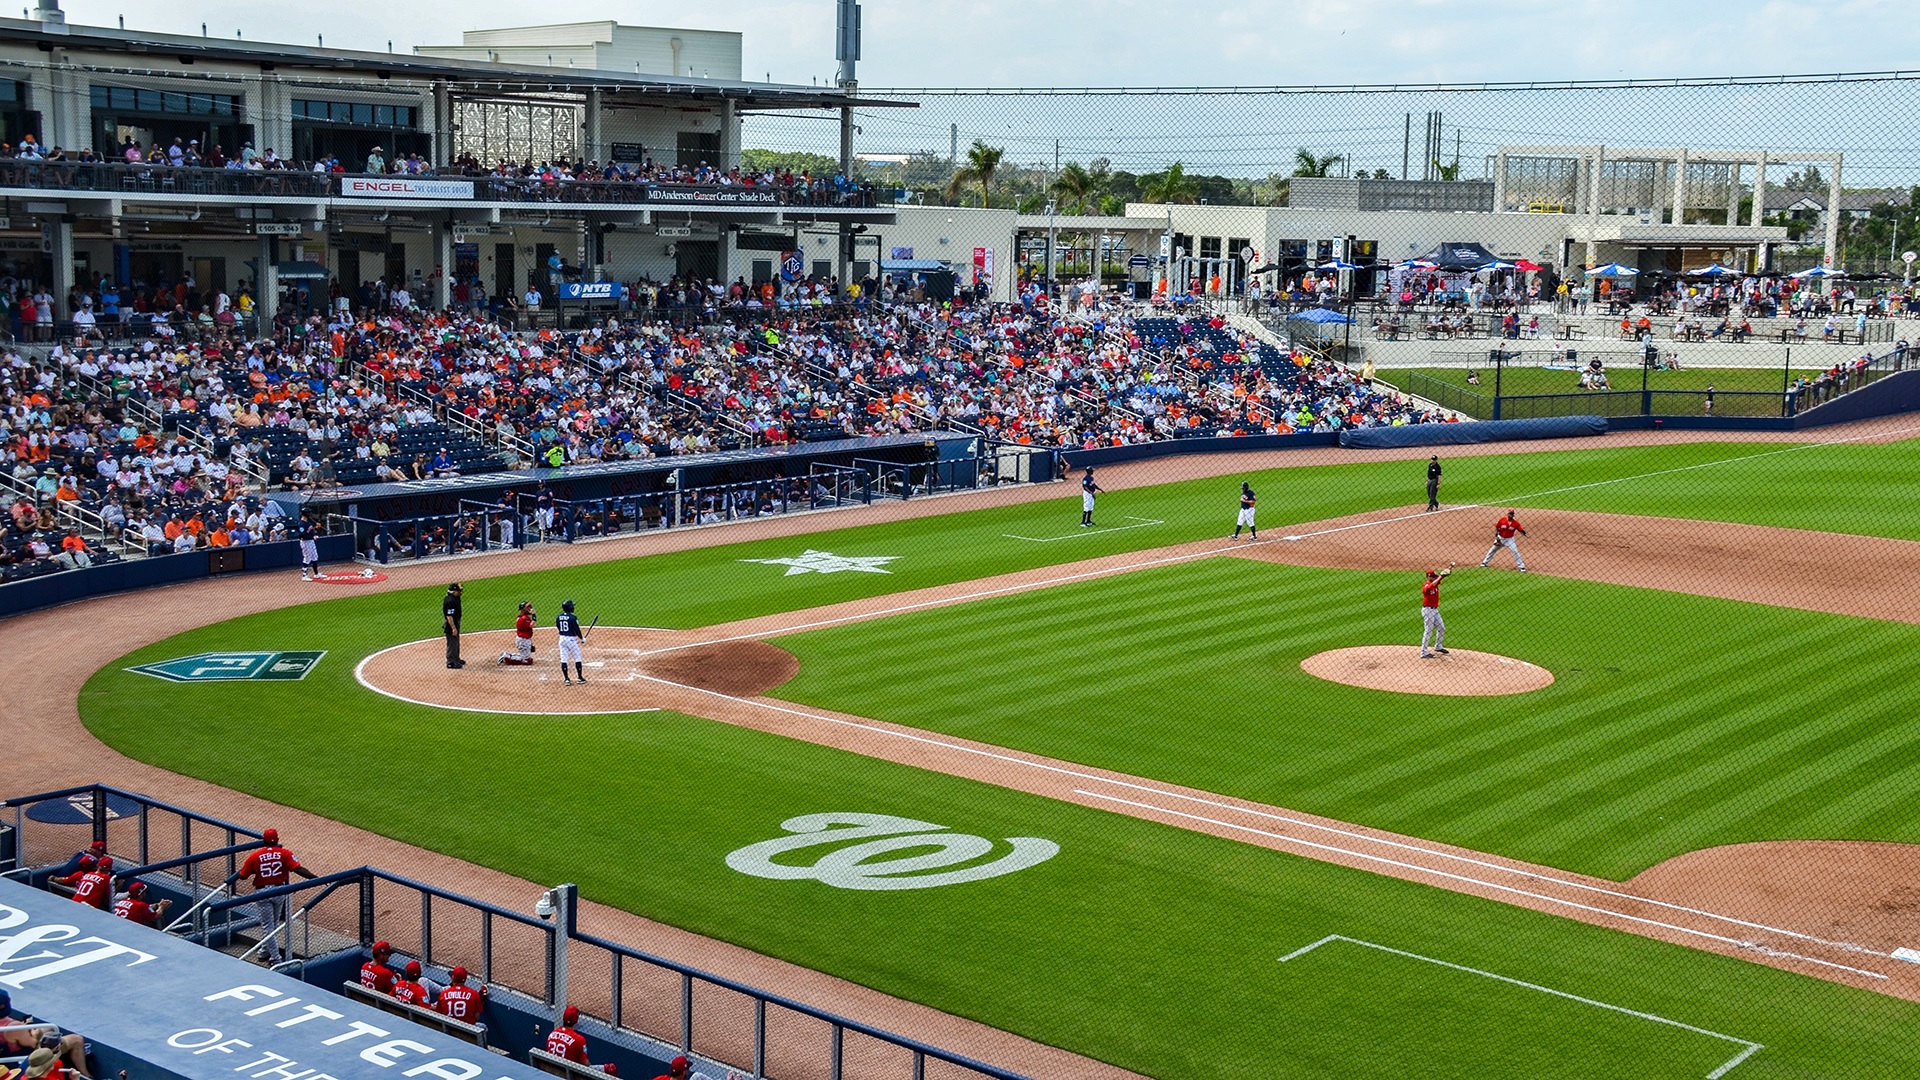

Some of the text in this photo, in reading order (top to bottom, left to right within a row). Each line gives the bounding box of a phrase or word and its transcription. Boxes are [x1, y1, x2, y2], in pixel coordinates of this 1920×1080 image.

[353, 181, 415, 193] ENGEL
[648, 190, 776, 202] MD Anderson Cancer Center Shade Deck
[783, 256, 800, 274] TFG
[582, 283, 612, 293] NTB
[559, 621, 569, 632] 18
[259, 851, 281, 862] FEBLES
[260, 861, 282, 878] 52
[76, 880, 94, 896] 10
[444, 991, 472, 1001] LOVULLO
[447, 1000, 467, 1017] 18
[203, 984, 515, 1080] FITTEA
[167, 1028, 253, 1055] OF
[548, 1040, 567, 1058] 39
